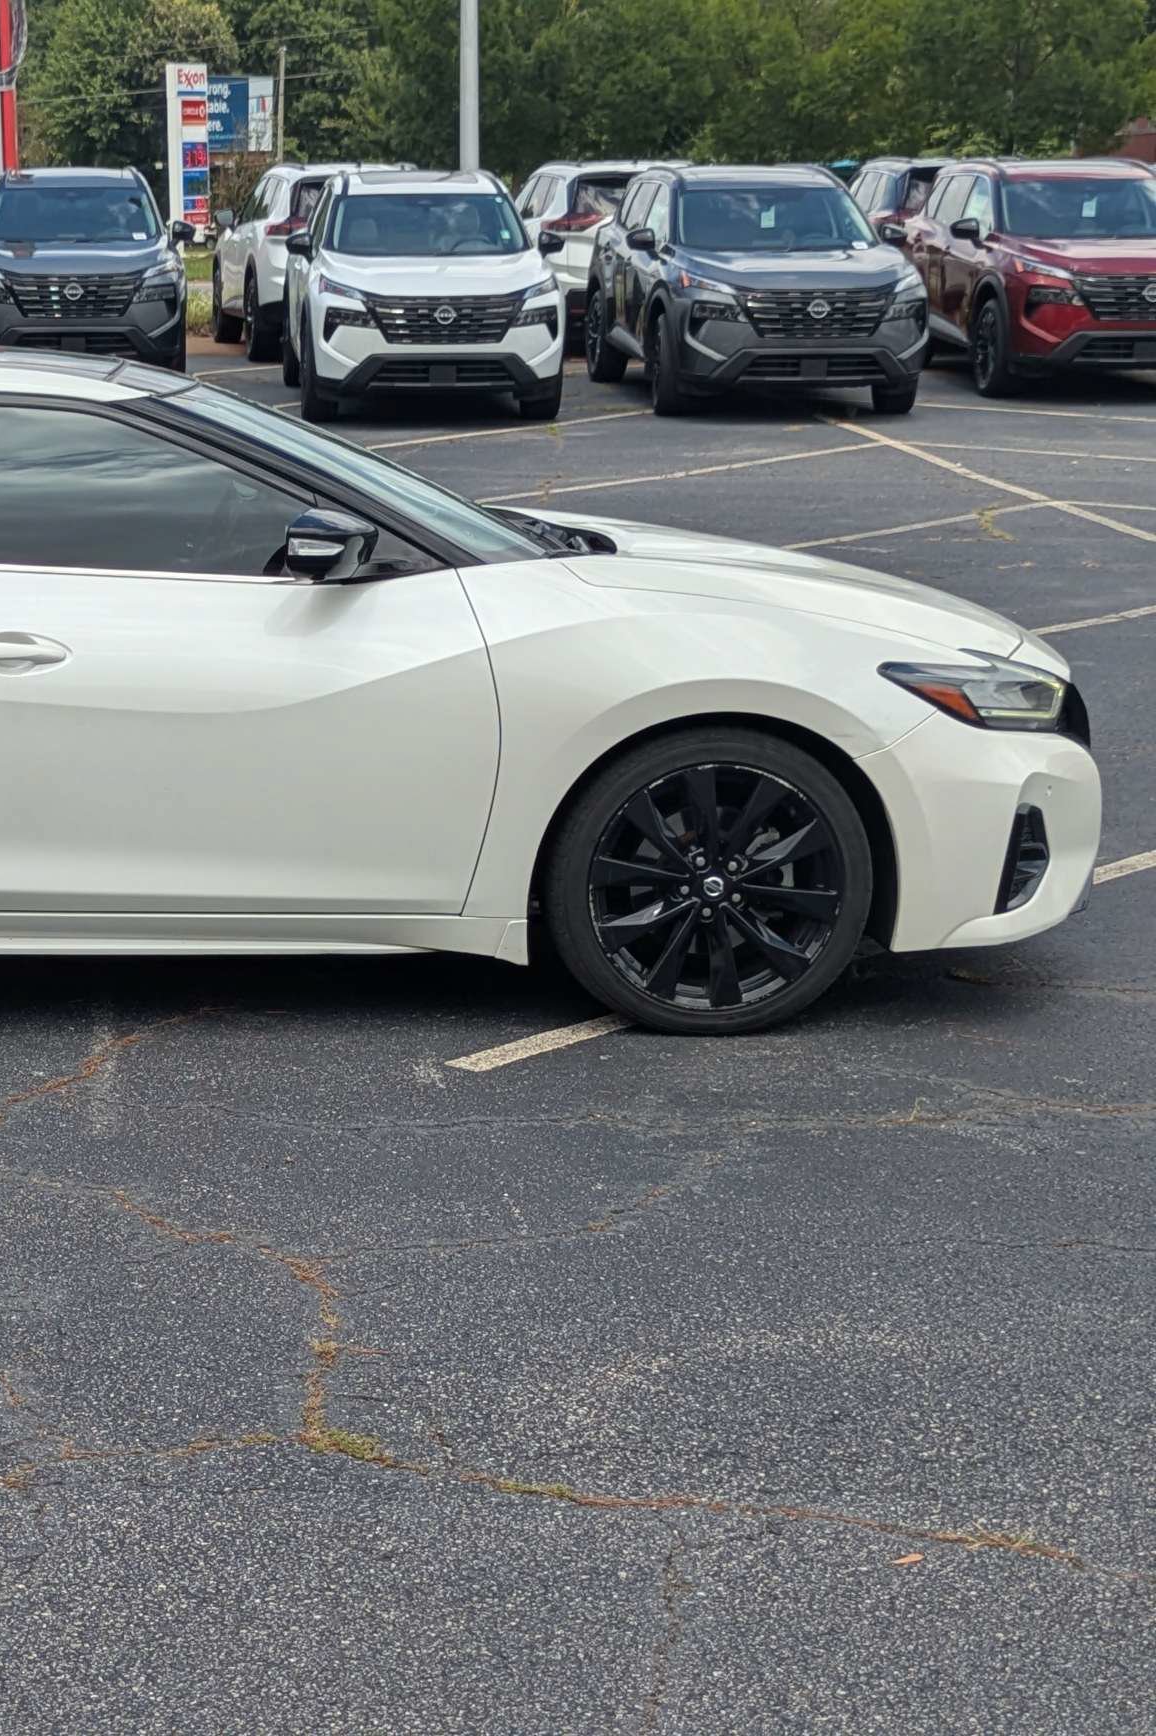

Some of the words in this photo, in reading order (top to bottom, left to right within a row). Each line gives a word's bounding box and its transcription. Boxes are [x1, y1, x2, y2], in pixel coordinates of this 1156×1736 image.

[177, 69, 205, 89] Exxon
[209, 82, 231, 99] rong.
[209, 100, 230, 113] able.
[207, 120, 224, 132] ere.
